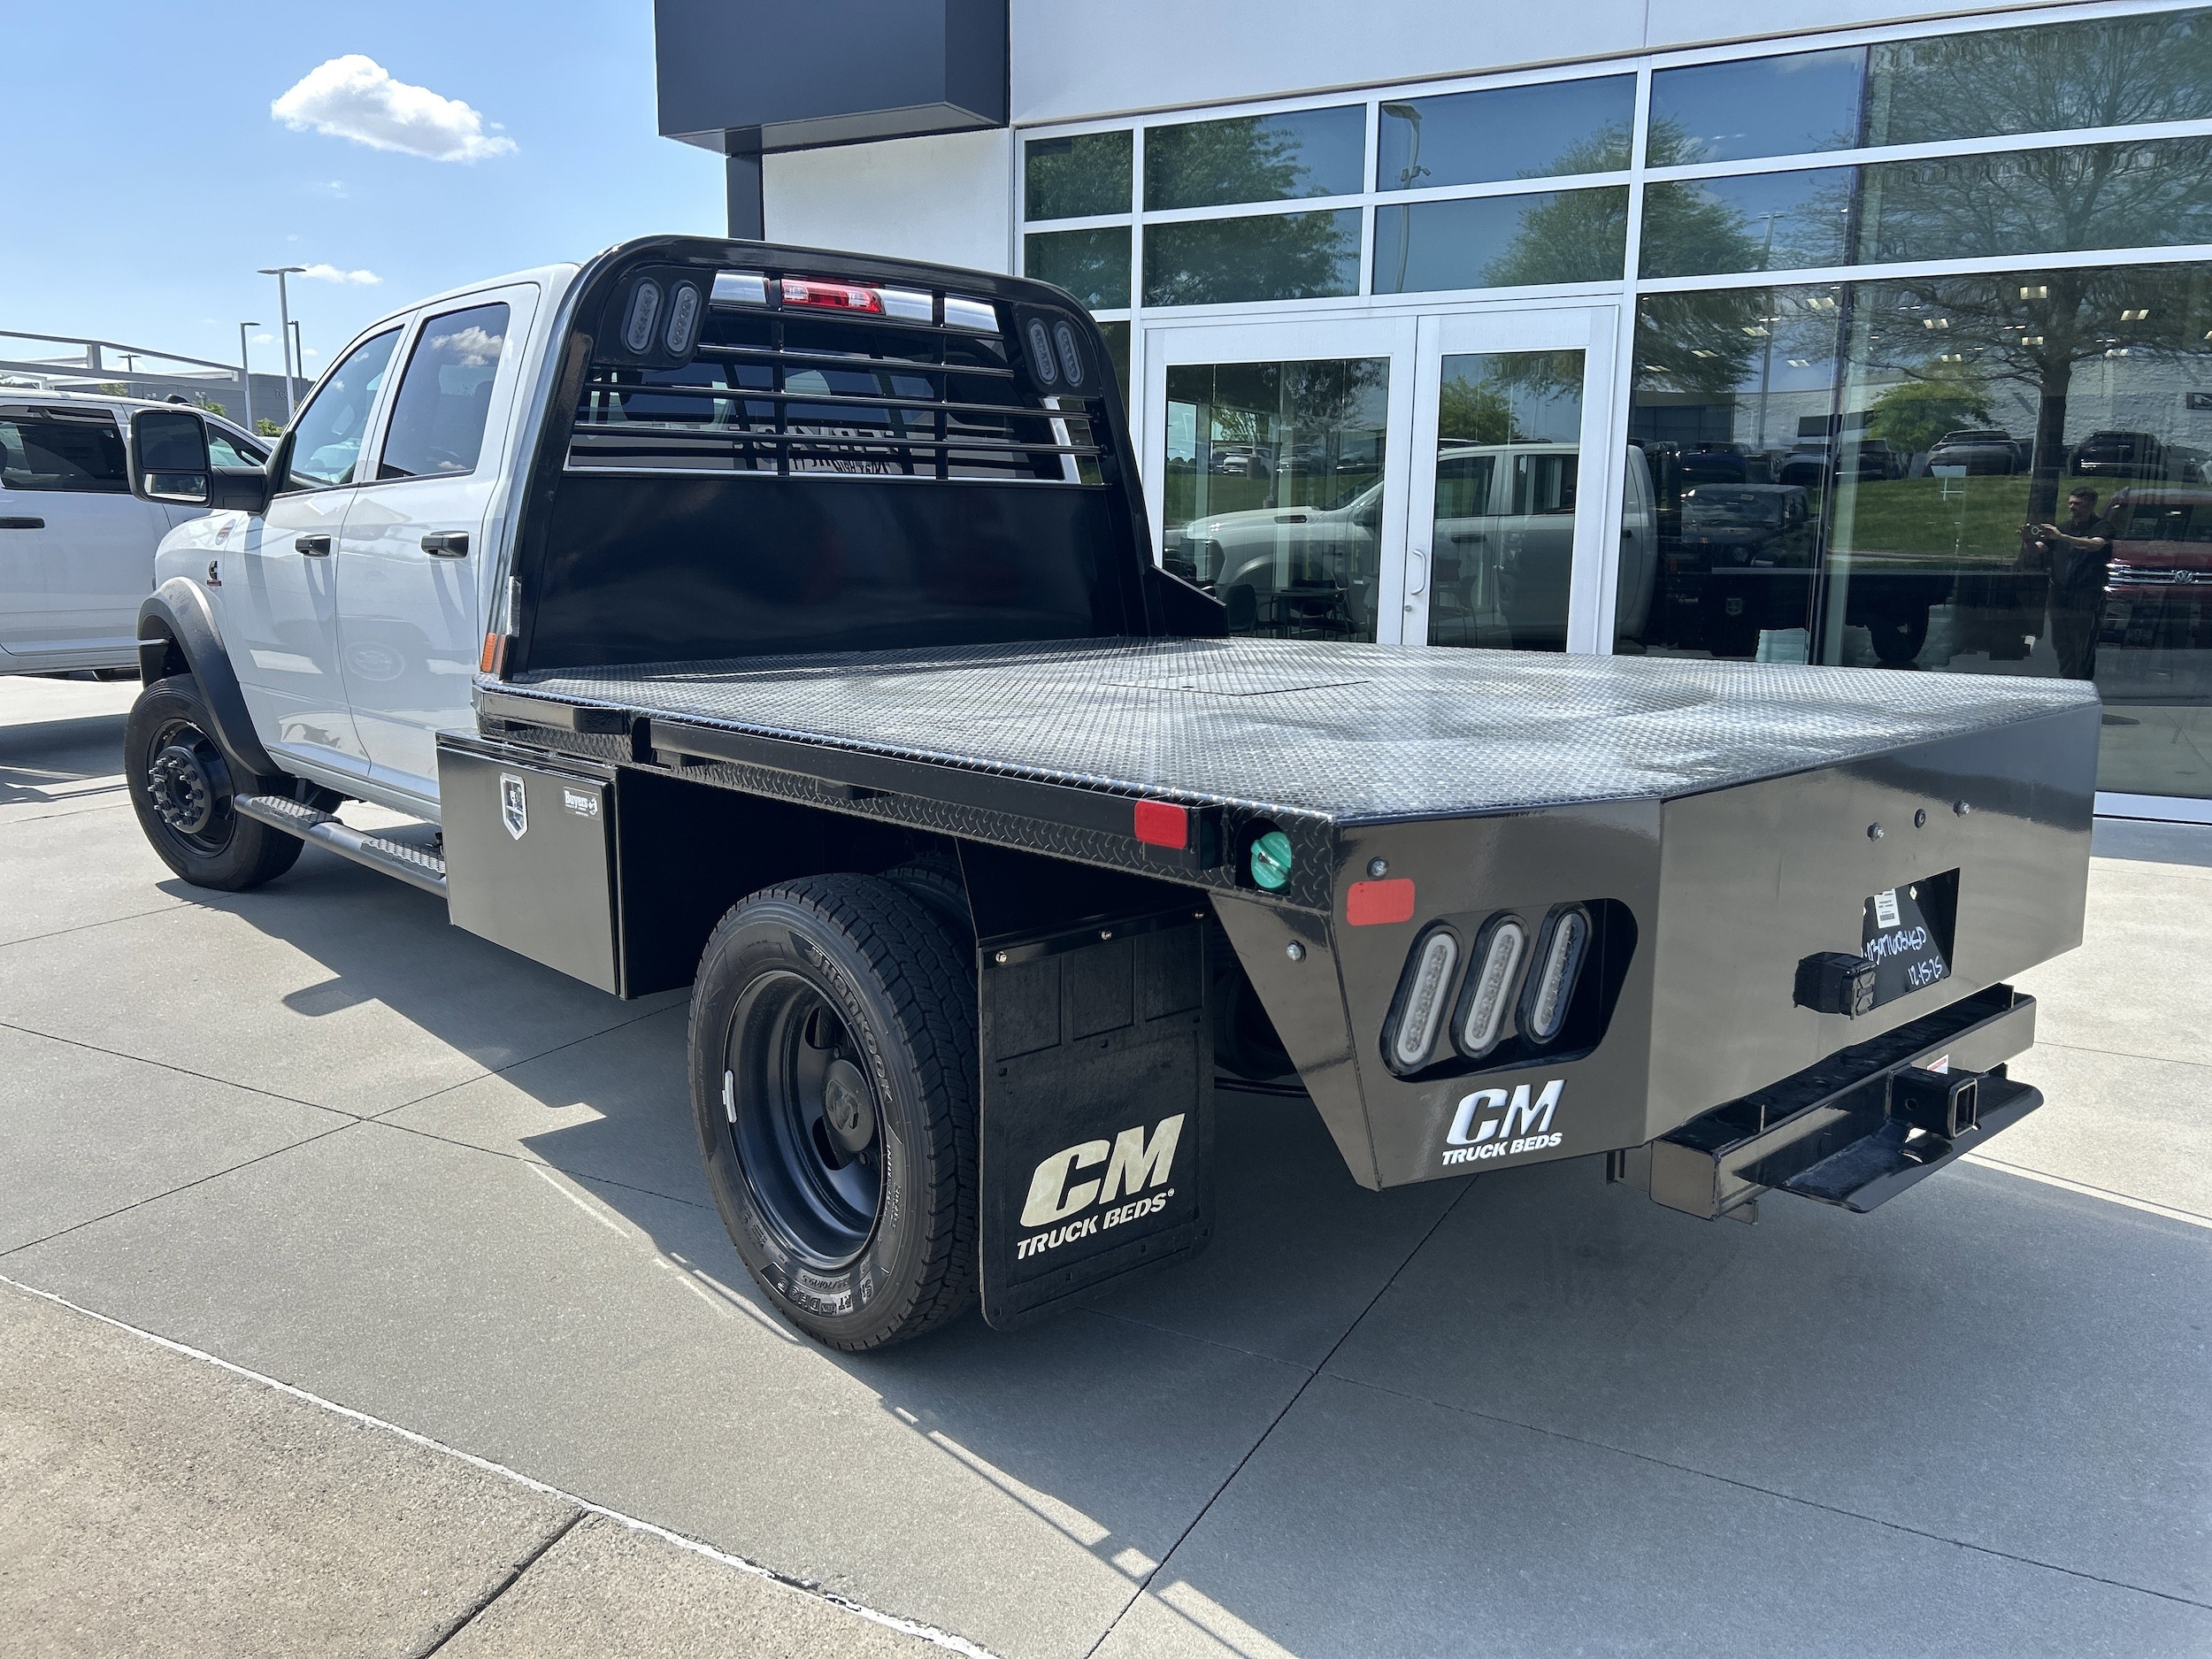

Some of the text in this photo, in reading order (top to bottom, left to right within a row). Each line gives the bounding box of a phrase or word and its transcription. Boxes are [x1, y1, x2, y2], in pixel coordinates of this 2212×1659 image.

[1445, 1079, 1565, 1145] CM
[1019, 1112, 1186, 1228] CM
[1441, 1132, 1563, 1166] TRUCK BEDS
[1017, 1215, 1099, 1261] TRUCK
